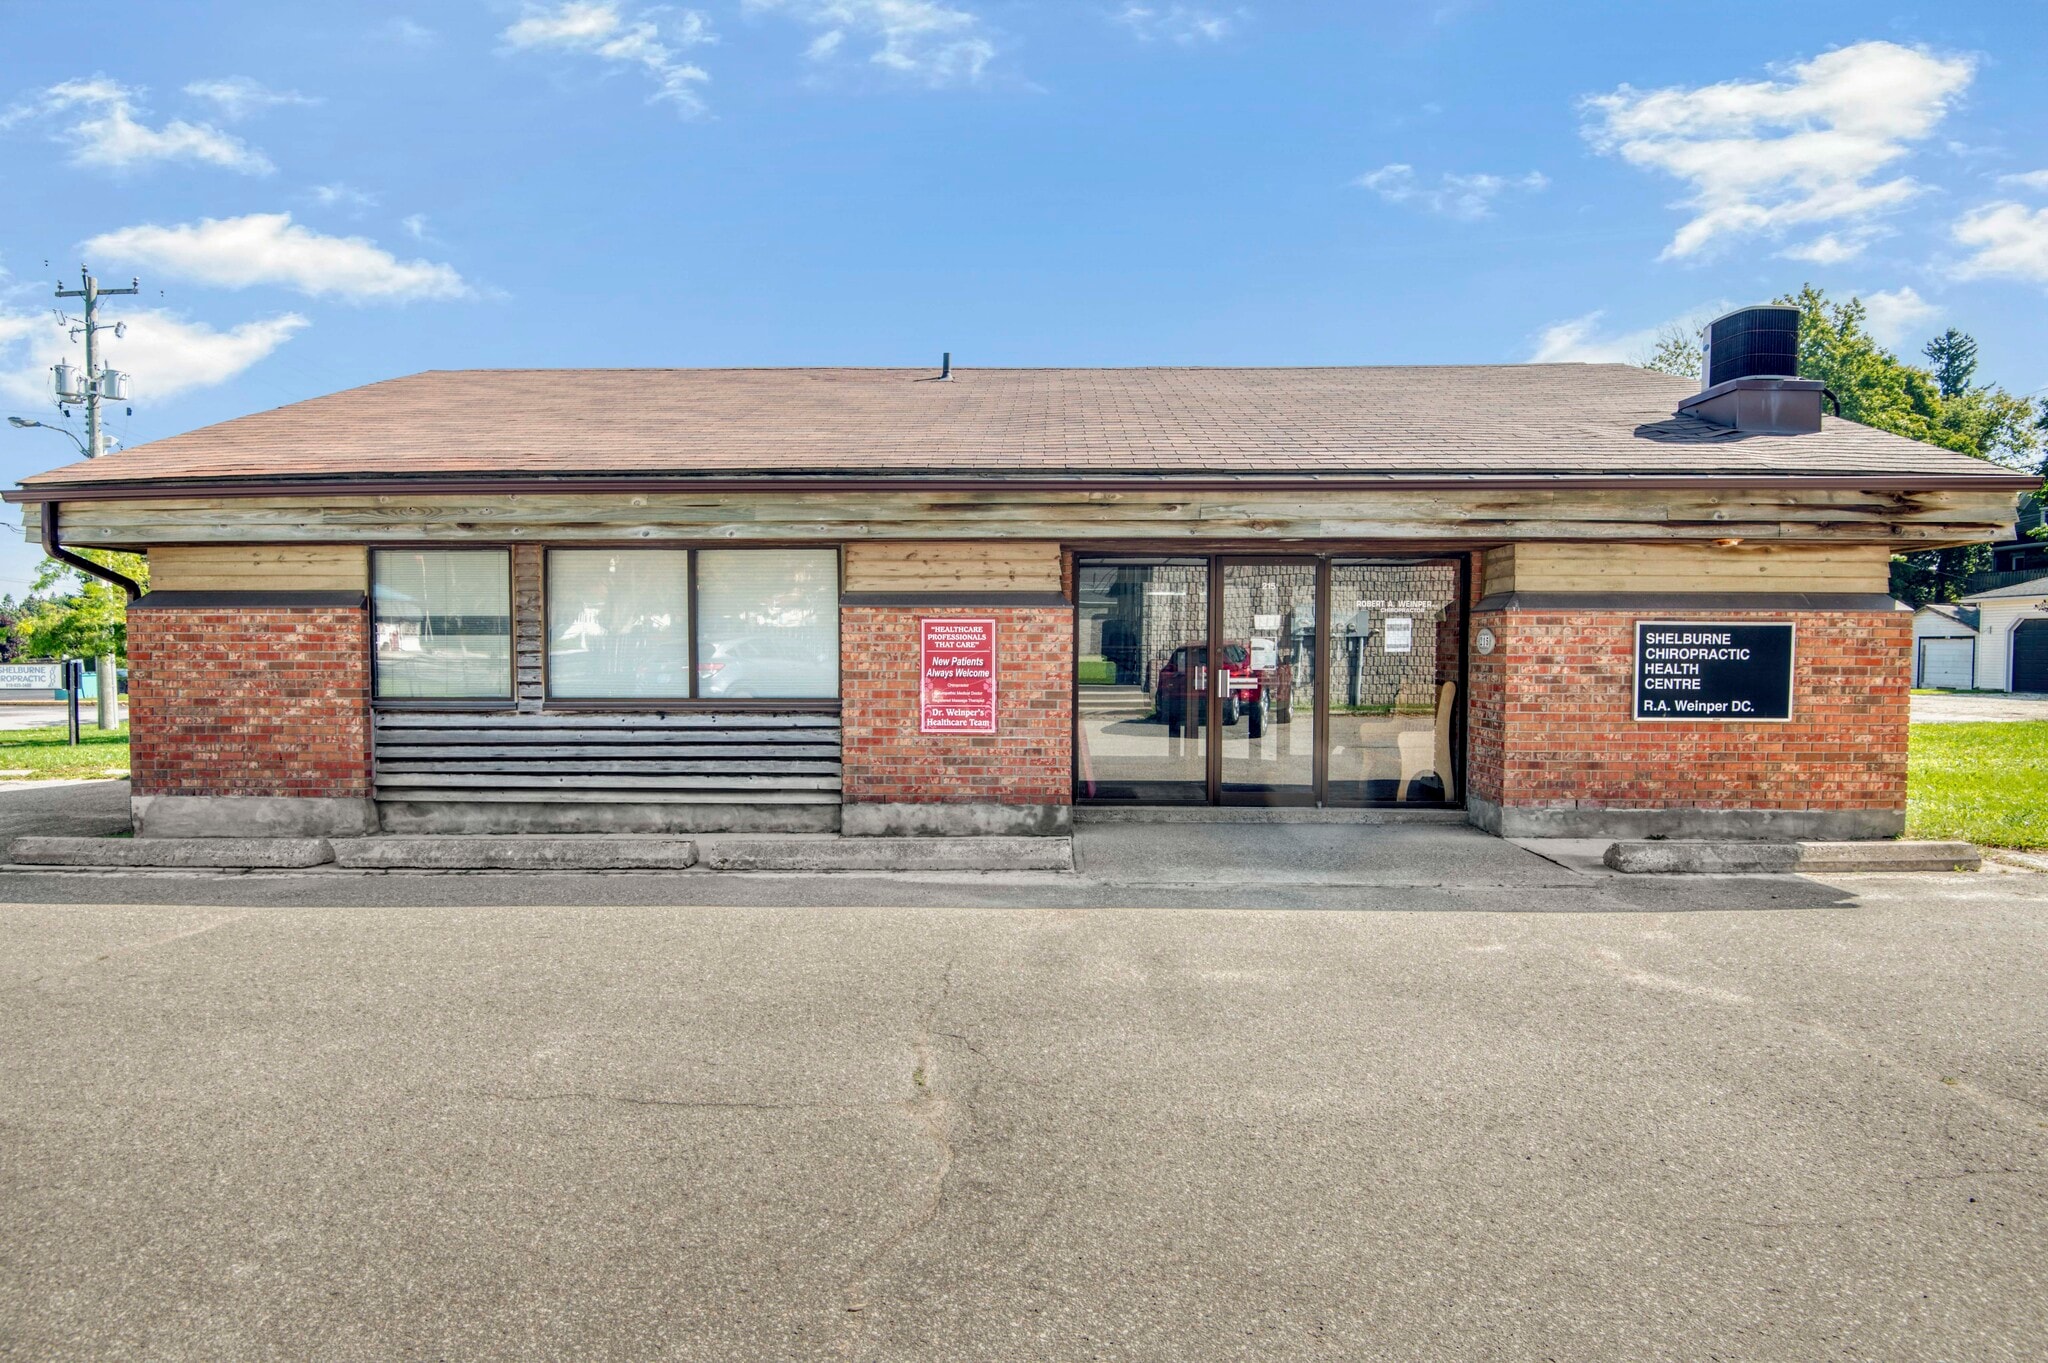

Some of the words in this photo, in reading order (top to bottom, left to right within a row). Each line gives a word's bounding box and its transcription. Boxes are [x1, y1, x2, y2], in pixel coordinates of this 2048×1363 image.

[1645, 633, 1732, 645] SHELBURNE
[1645, 648, 1751, 660] CHIROPRACTIC
[932, 656, 950, 666] New
[951, 656, 984, 666] Patients
[926, 668, 953, 679] Always
[955, 668, 990, 678] Welcome
[1645, 663, 1699, 675] HEALTH
[1644, 678, 1701, 690] CENTRE
[932, 708, 944, 716] Dr.
[946, 708, 985, 717] Weinper's
[1643, 700, 1671, 712] R.A.
[1675, 700, 1728, 714] Weinper
[1731, 701, 1755, 713] DC.
[927, 718, 967, 726] Healthcare
[968, 718, 990, 726] Team
